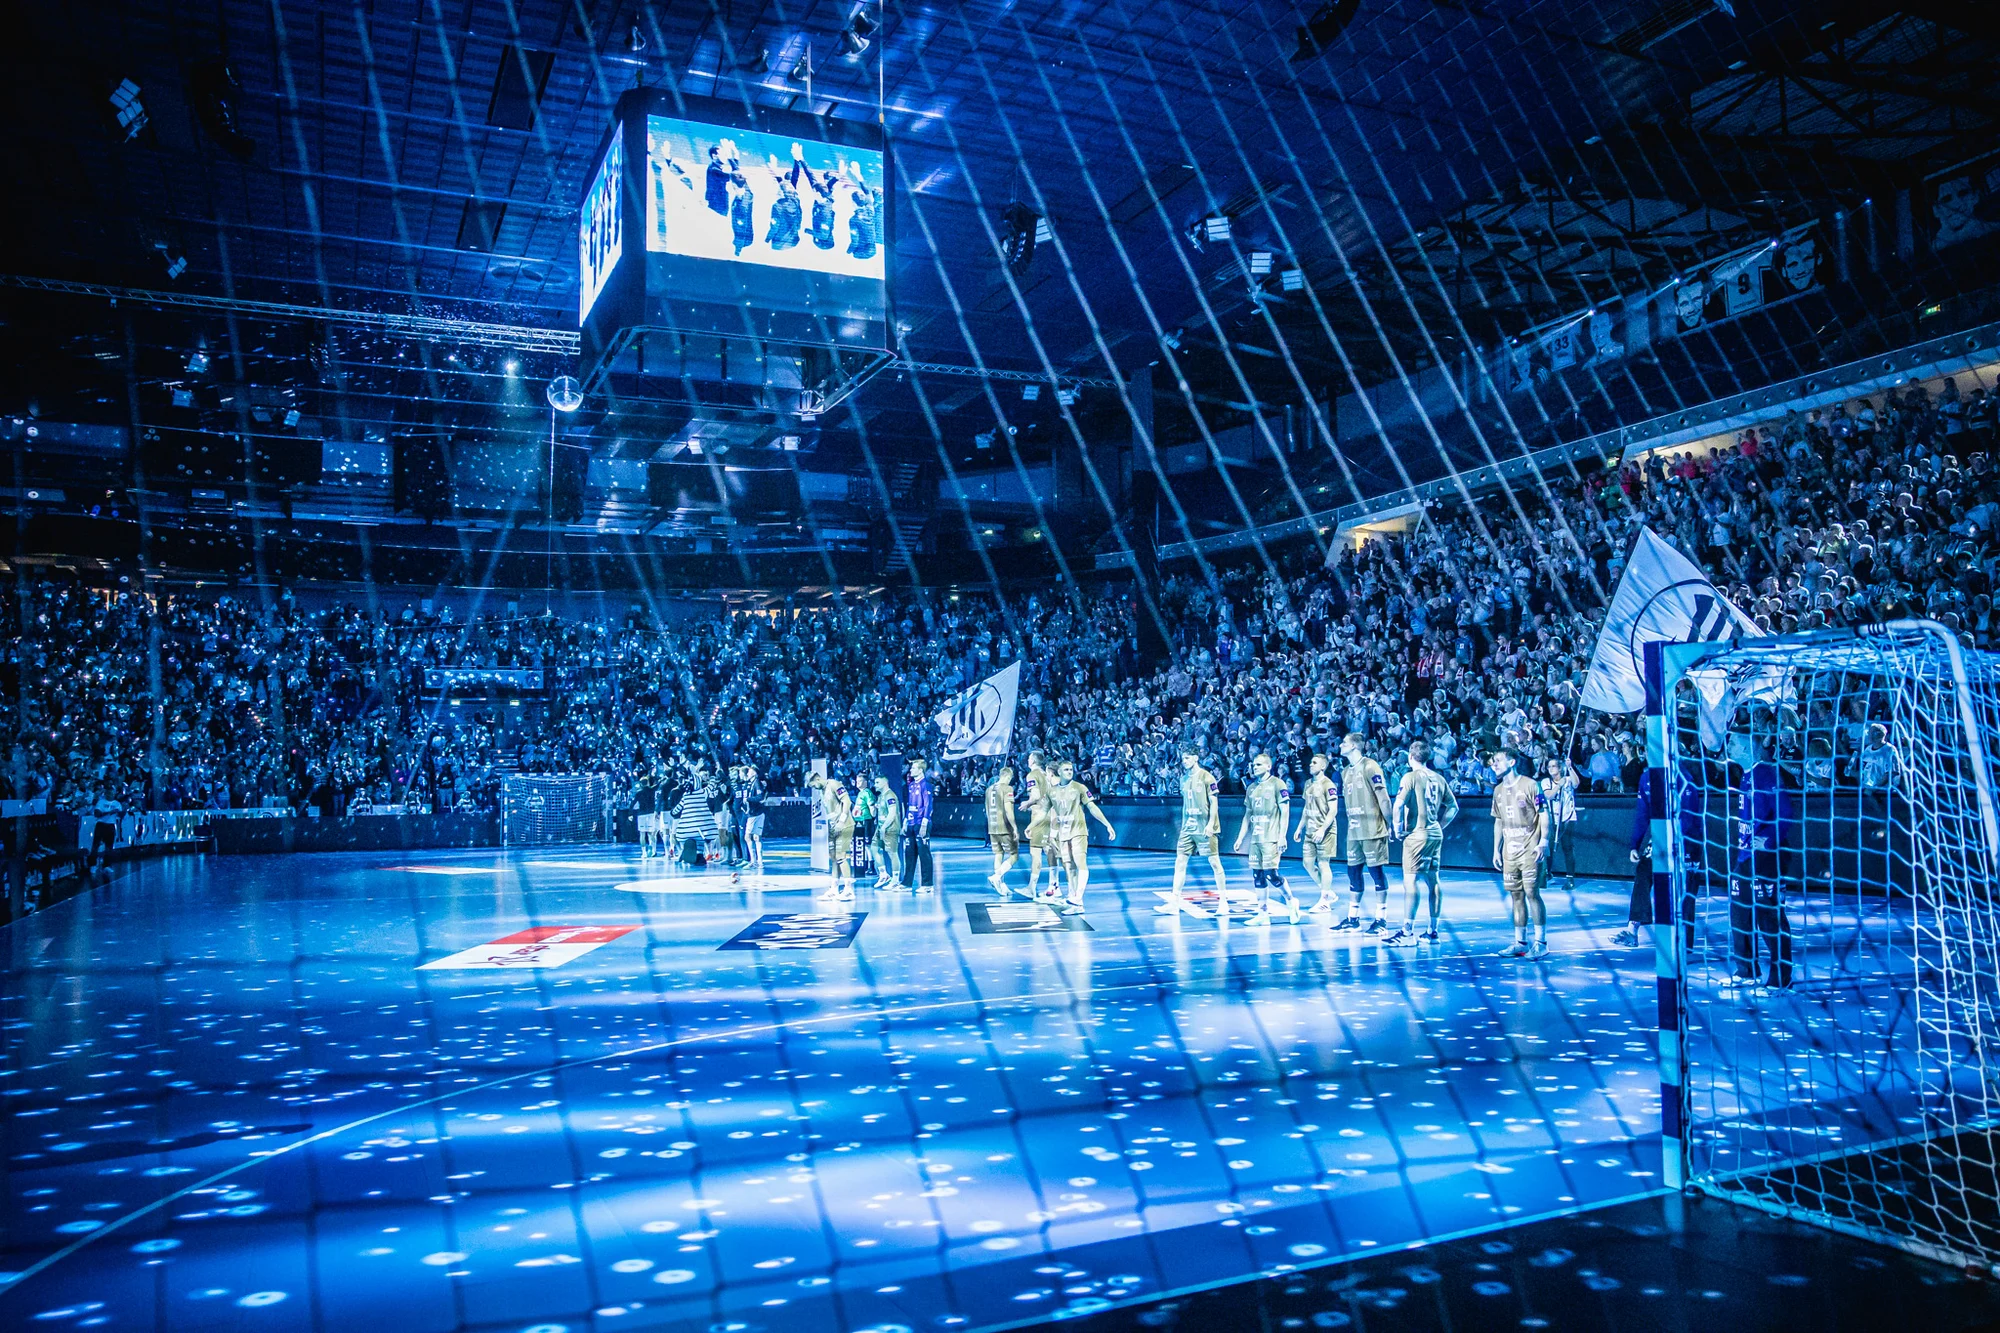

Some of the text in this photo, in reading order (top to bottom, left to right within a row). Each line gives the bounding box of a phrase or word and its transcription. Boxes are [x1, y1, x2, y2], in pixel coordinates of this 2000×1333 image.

[1738, 273, 1750, 295] 9
[1554, 336, 1570, 351] 33
[990, 791, 996, 806] 6
[856, 836, 864, 867] SELECT
